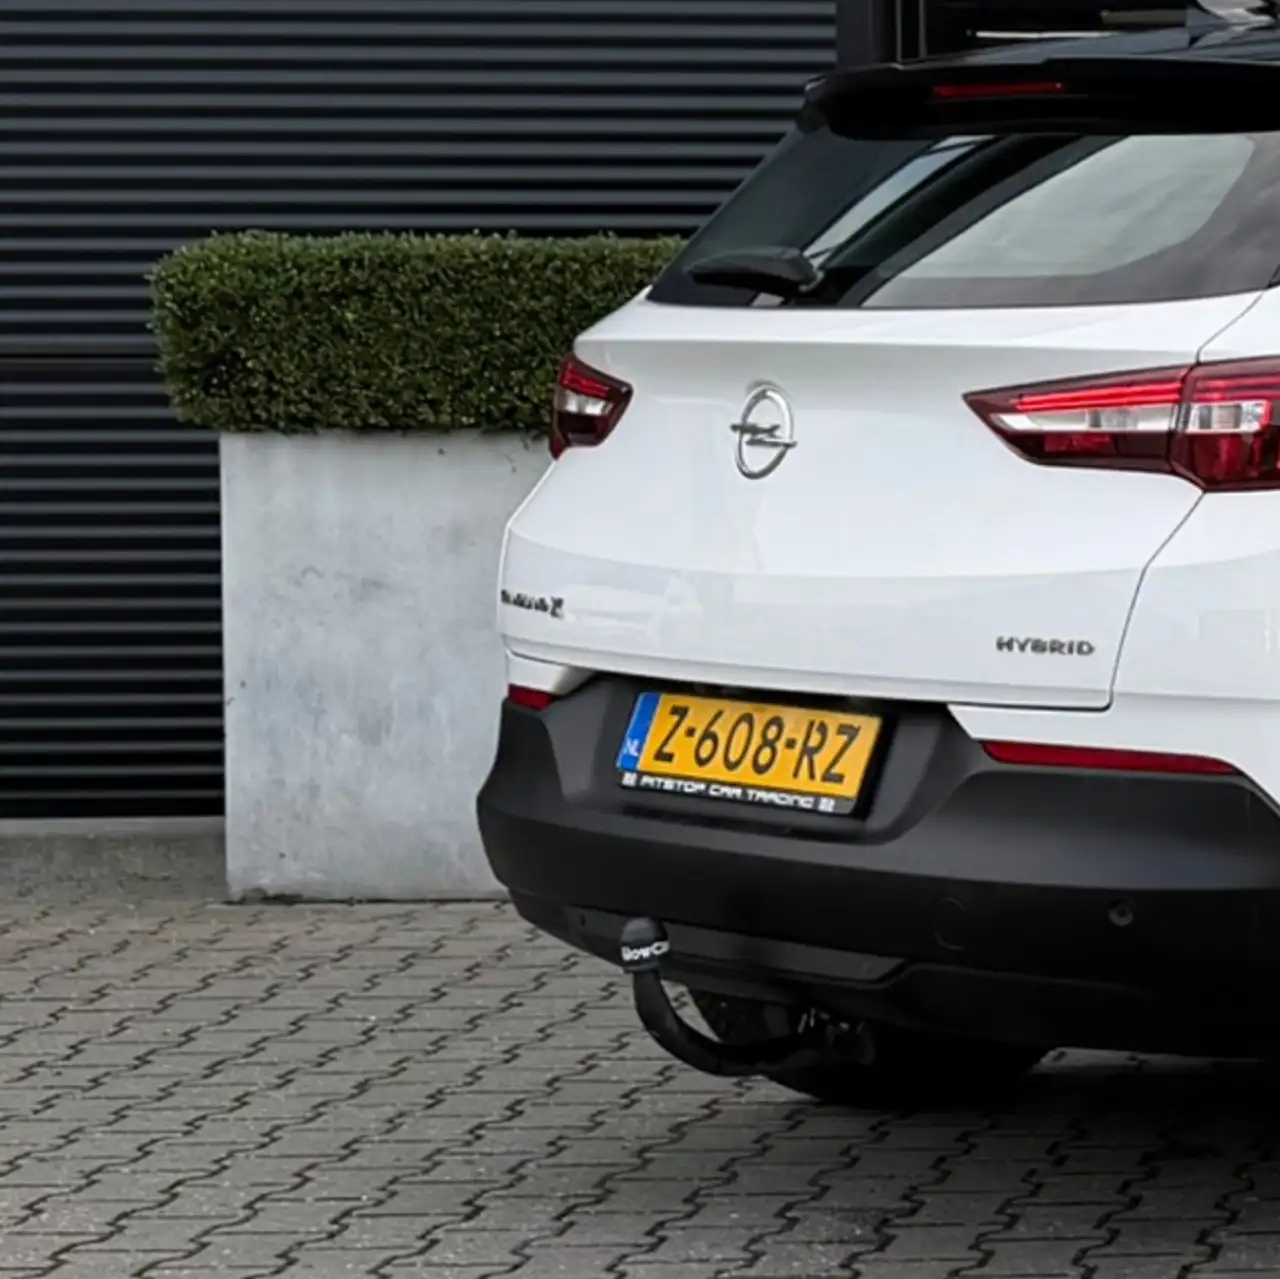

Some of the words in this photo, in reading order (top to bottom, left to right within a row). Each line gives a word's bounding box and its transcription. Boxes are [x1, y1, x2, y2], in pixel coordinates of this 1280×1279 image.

[995, 635, 1096, 657] HYBRID
[623, 738, 640, 756] NL
[653, 704, 861, 784] Z-608-RZ
[640, 775, 706, 794] PITSTOP
[708, 784, 744, 801] CAR
[746, 789, 815, 811] TRADING
